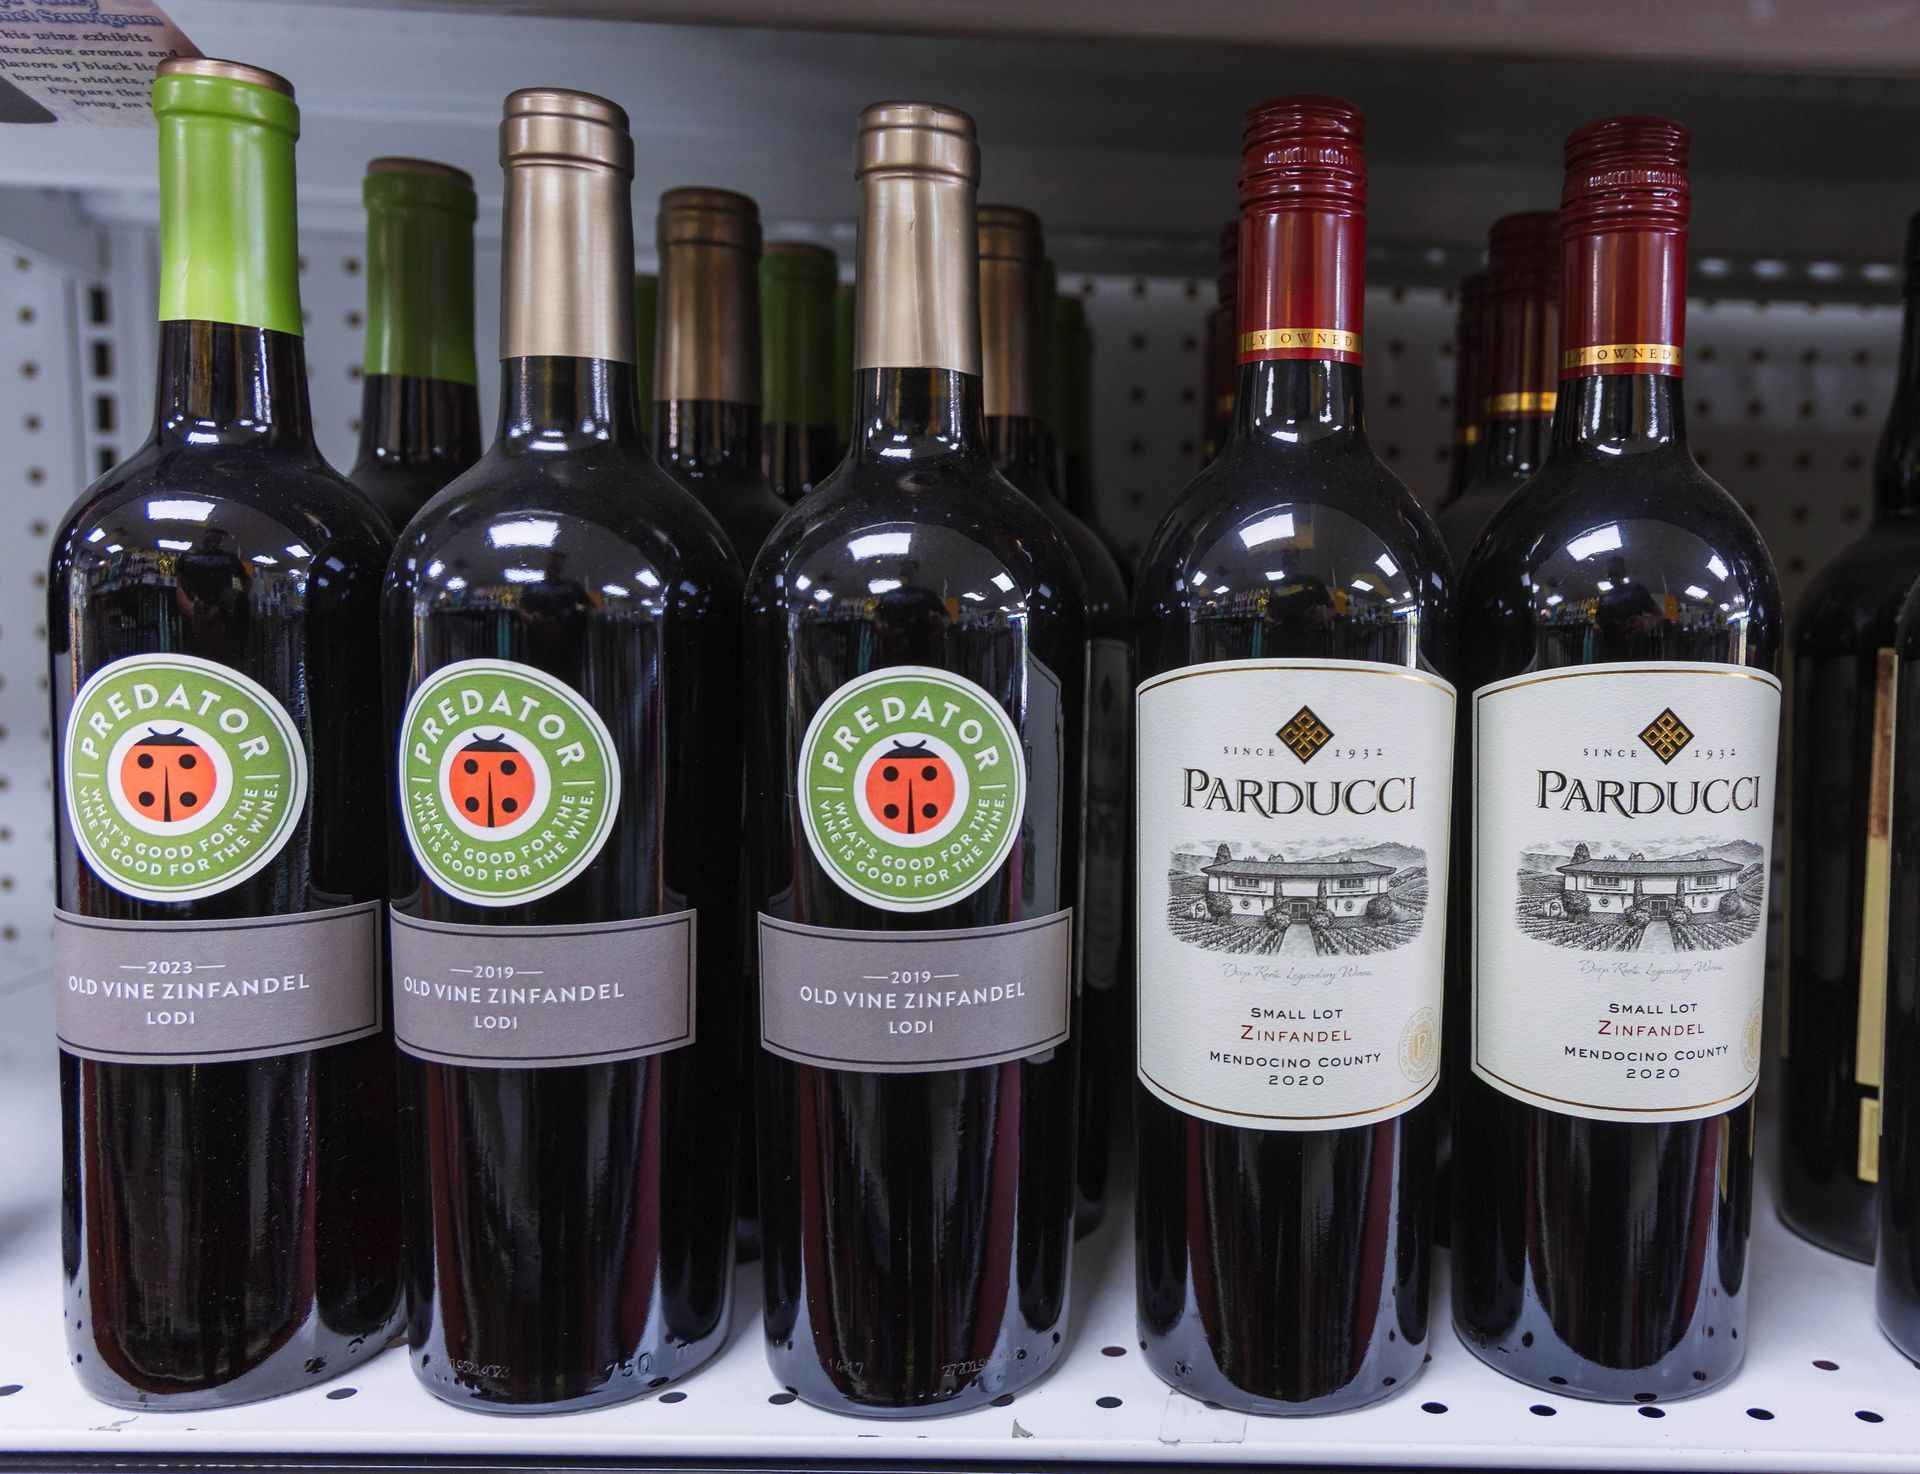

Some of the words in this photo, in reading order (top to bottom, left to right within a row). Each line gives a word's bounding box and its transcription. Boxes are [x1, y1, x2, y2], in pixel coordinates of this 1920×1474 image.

[36, 9, 164, 28] Sauvignon
[0, 29, 31, 39] his
[33, 31, 78, 40] wine
[82, 32, 153, 42] exhibits
[78, 49, 143, 57] aromas
[62, 62, 80, 72] of
[84, 61, 132, 71] black
[48, 86, 112, 97] Prepare
[117, 89, 145, 97] the
[122, 101, 142, 109] on
[1280, 333, 1353, 347] OWNED
[1597, 347, 1671, 360] OWNED
[81, 683, 270, 761] PREDATOR
[414, 690, 585, 767] PREDATOR
[822, 696, 999, 773] PREDATOR
[1223, 746, 1275, 757] SINCE
[1335, 748, 1383, 760] 1932
[1583, 748, 1638, 758] SINCE
[1695, 748, 1737, 760] 1932
[1182, 768, 1416, 819] PARDUCCI
[1535, 769, 1761, 820] PARDUCCI
[80, 786, 98, 830] VINE
[96, 831, 109, 848] IS
[111, 848, 162, 875] GOOD
[170, 859, 210, 876] FOR
[214, 838, 250, 864] THE
[247, 783, 279, 835] WINE.
[92, 788, 131, 846] WHAT'S
[135, 842, 193, 860] GOOD
[199, 823, 237, 851] FOR
[234, 789, 258, 824] THE
[424, 793, 461, 851] WHAT'S
[464, 848, 515, 864] GOOD
[521, 829, 556, 857] FOR
[552, 795, 574, 827] THE
[413, 791, 430, 834] VINE
[429, 836, 441, 852] IS
[442, 853, 487, 880] GOOD
[495, 865, 532, 881] FOR
[534, 841, 568, 870] THE
[565, 790, 595, 840] WINE.
[820, 800, 841, 842] VINE
[839, 844, 852, 861] IS
[856, 860, 907, 887] GOOD
[914, 870, 950, 887] FOR
[952, 847, 984, 874] THE
[981, 792, 1006, 844] WINE.
[833, 801, 877, 859] WHAT'S
[881, 855, 935, 870] GOOD
[940, 833, 973, 862] FOR
[969, 798, 990, 831] THE
[147, 961, 193, 974] 2023
[474, 966, 514, 979] 2019
[891, 971, 931, 984] 2019
[69, 975, 98, 996] OLD
[102, 981, 155, 999] VINE
[162, 974, 310, 999] ZINFANDEL
[404, 976, 430, 996] OLD
[435, 983, 481, 1003] VINE
[488, 982, 625, 1004] ZINFANDEL
[800, 986, 837, 1006] OLD
[844, 991, 896, 1009] VINE
[905, 982, 1025, 1009] ZINFANDEL
[1251, 1007, 1306, 1020] SMALL
[1312, 1008, 1343, 1020] LOT
[1609, 1003, 1664, 1014] SMALL
[1670, 1003, 1698, 1014] LOT
[146, 1011, 195, 1025] LODI
[475, 1016, 518, 1030] LODI
[889, 1021, 934, 1034] LODI
[1241, 1024, 1352, 1042] ZINFANDEL
[1598, 1020, 1705, 1037] ZINFANDEL
[1210, 1051, 1311, 1069] MENDOCINO
[1318, 1052, 1381, 1068] COUNTY
[1565, 1046, 1668, 1062] MENDOCINO
[1674, 1045, 1729, 1061] COUNTY
[1268, 1075, 1324, 1087] 2020
[1626, 1068, 1680, 1079] 2020
